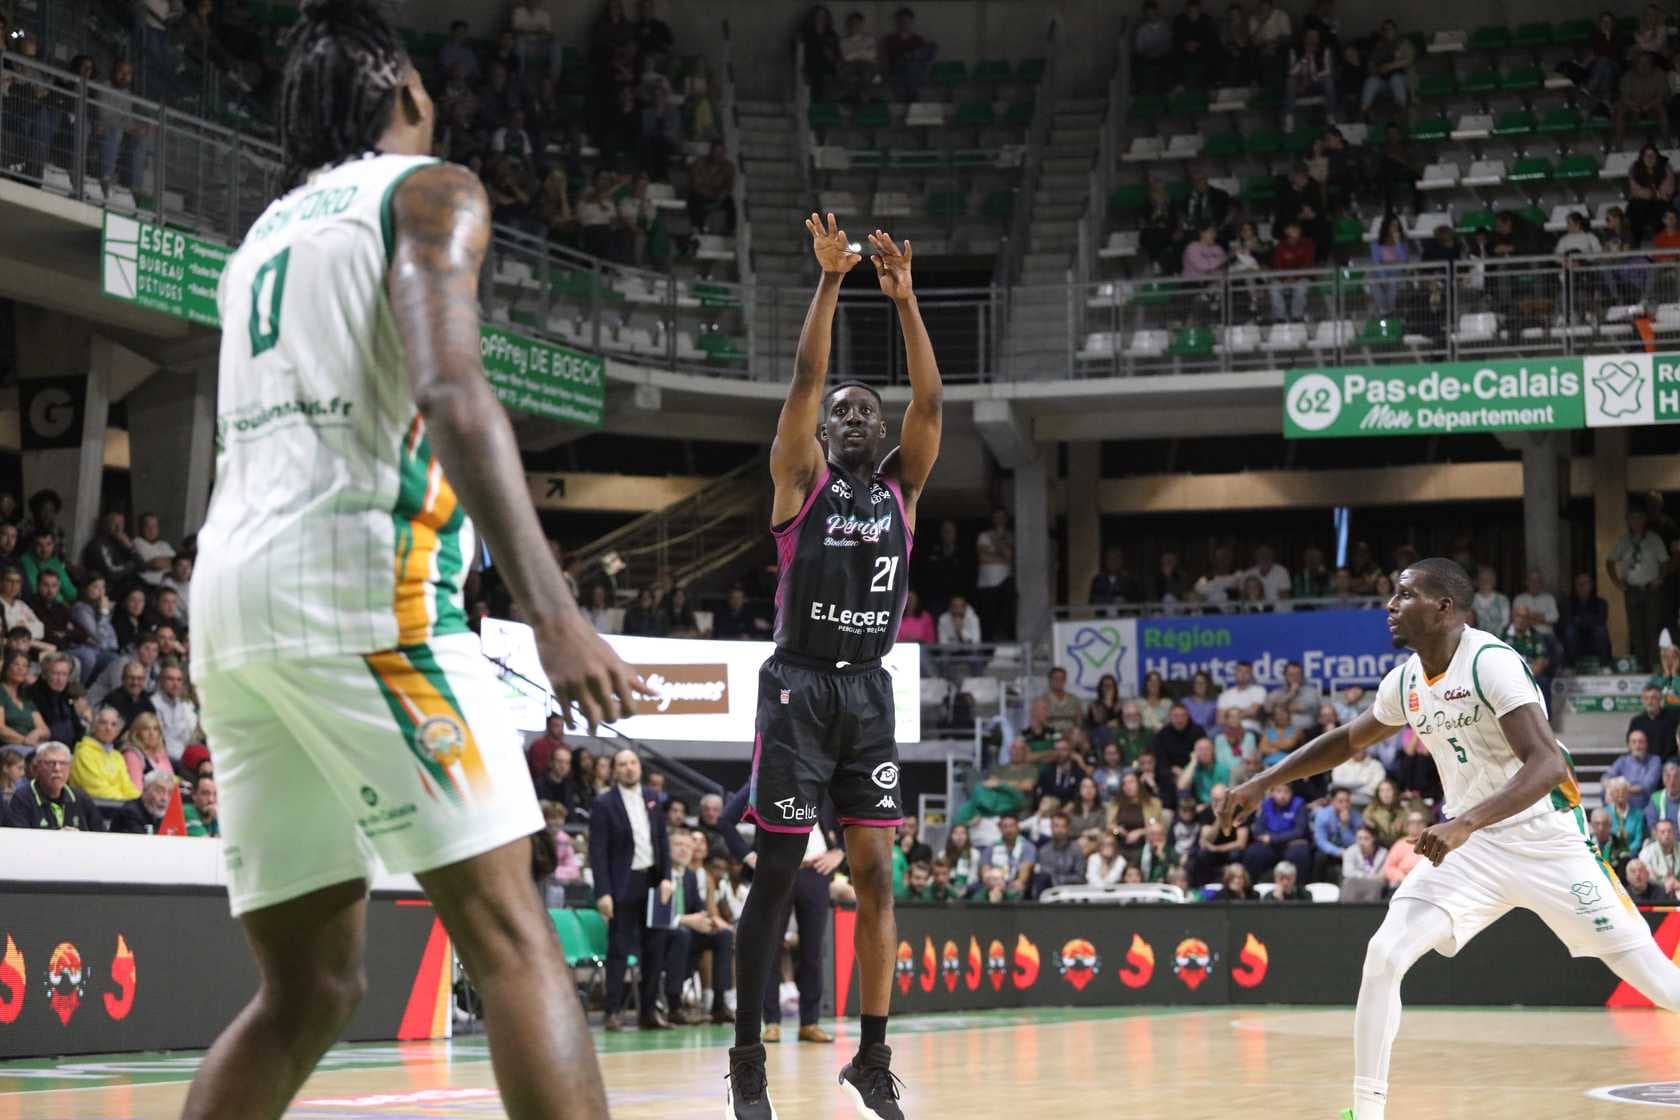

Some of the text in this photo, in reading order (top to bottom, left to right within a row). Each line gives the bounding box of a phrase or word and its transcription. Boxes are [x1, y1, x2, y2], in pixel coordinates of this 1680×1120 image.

[140, 223, 185, 259] ESER
[139, 254, 184, 280] BUREAU
[249, 246, 290, 357] 0
[530, 346, 548, 374] DE
[551, 352, 600, 386] BOECK
[29, 388, 74, 438] G
[1296, 388, 1331, 414] 62
[1360, 403, 1554, 432] Mon Département
[870, 556, 899, 593] 21
[1144, 625, 1232, 653] Région
[1447, 737, 1468, 764] 5
